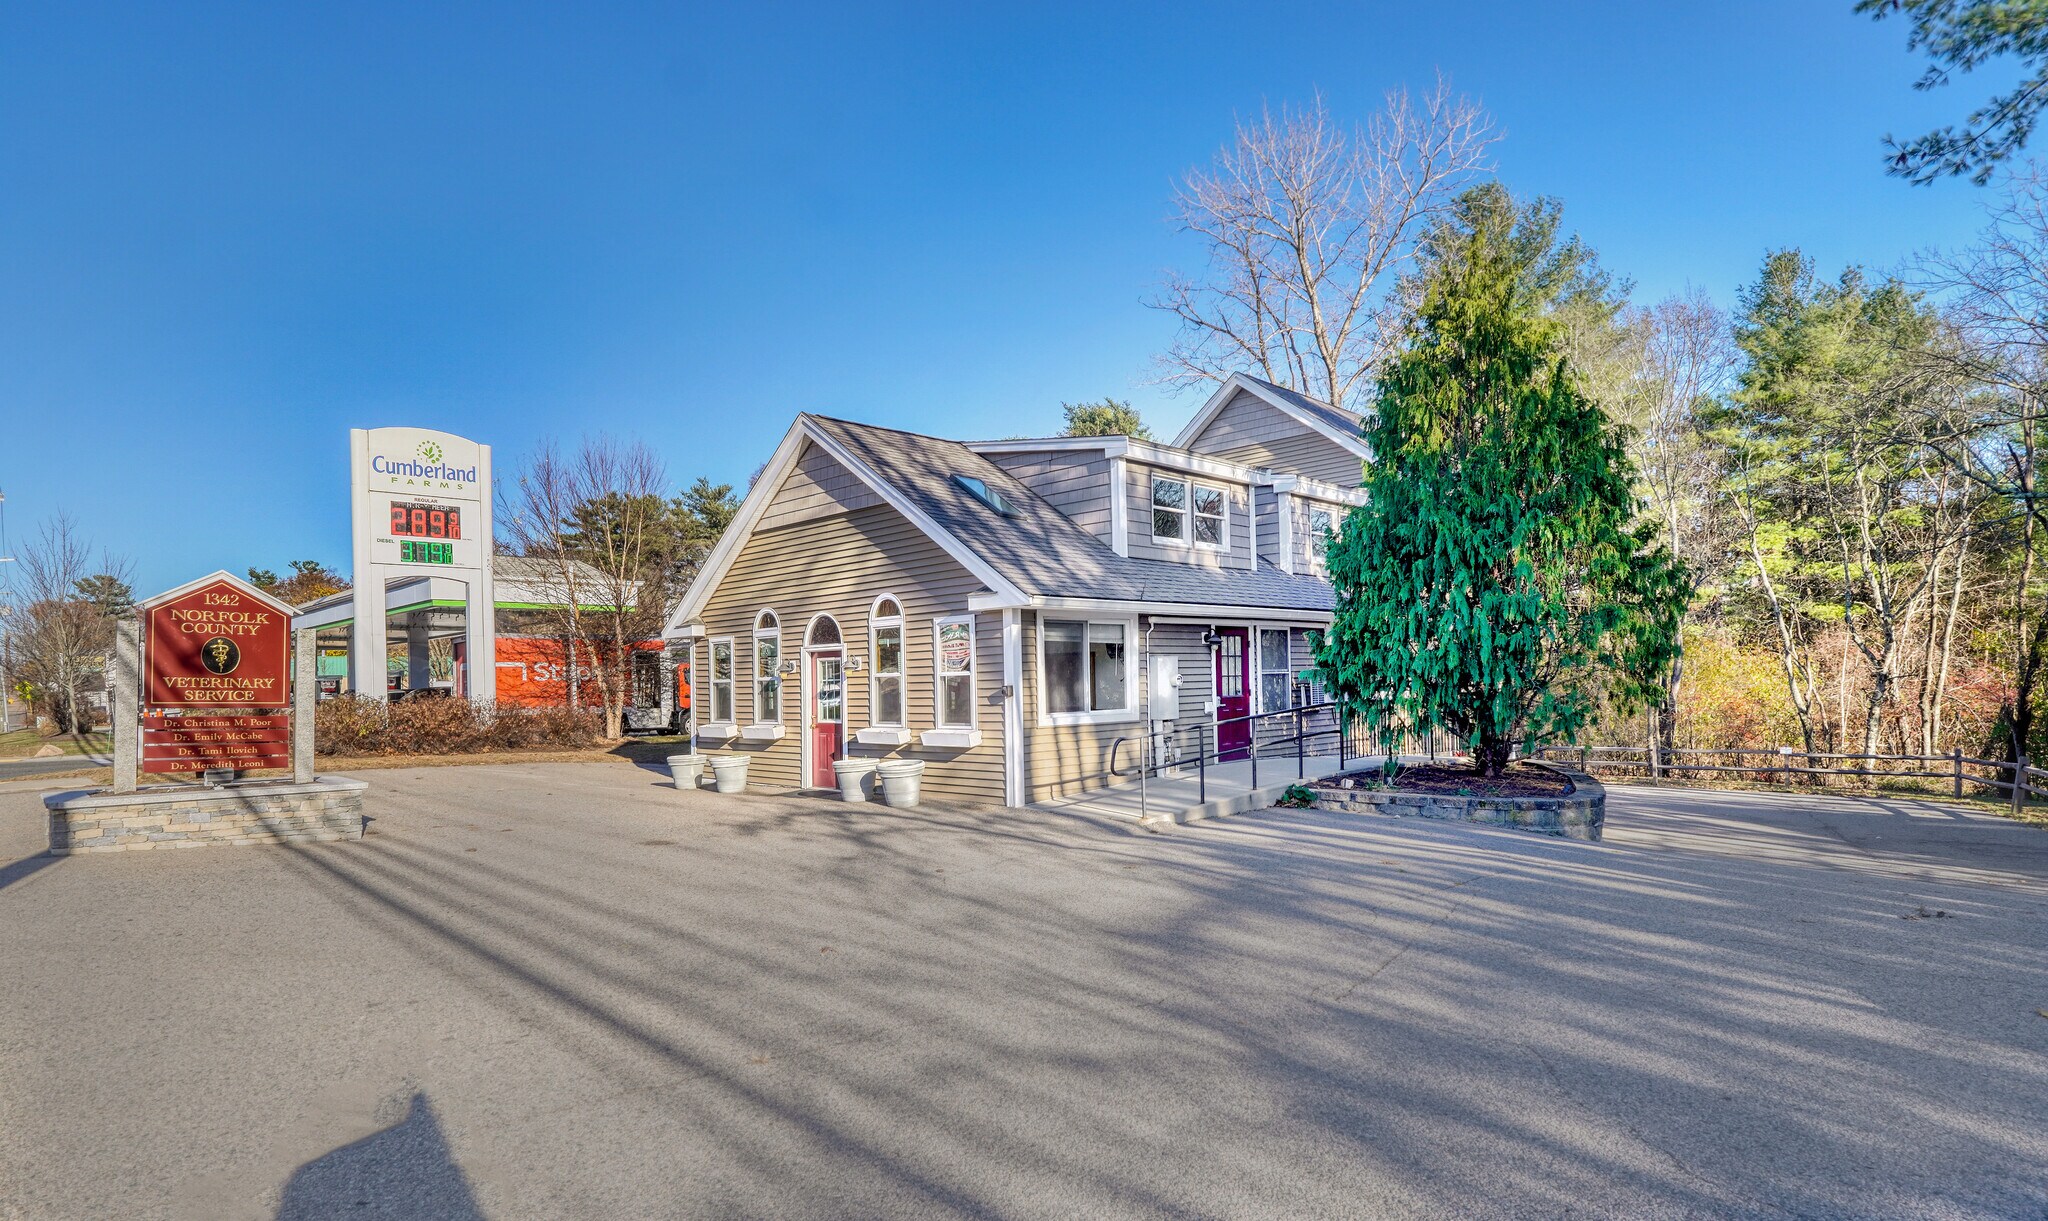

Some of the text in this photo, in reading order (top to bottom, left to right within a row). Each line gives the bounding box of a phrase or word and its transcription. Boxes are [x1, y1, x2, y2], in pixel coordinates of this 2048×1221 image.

[372, 455, 476, 483] Cumberland
[391, 476, 464, 490] FARMS
[203, 593, 240, 606] 1342
[170, 609, 270, 625] NORFOLK
[181, 622, 260, 636] COUNTY
[163, 676, 275, 689] VETERINARY
[184, 690, 255, 701] SERVICE
[184, 719, 230, 727] Christina
[234, 718, 247, 726] M.
[250, 718, 272, 726] Poor
[174, 731, 263, 742] Dr. Emily McCabe
[178, 746, 258, 756] Dr. Tami Ilovich
[171, 762, 187, 770] Dr.
[191, 761, 235, 769] Meredith
